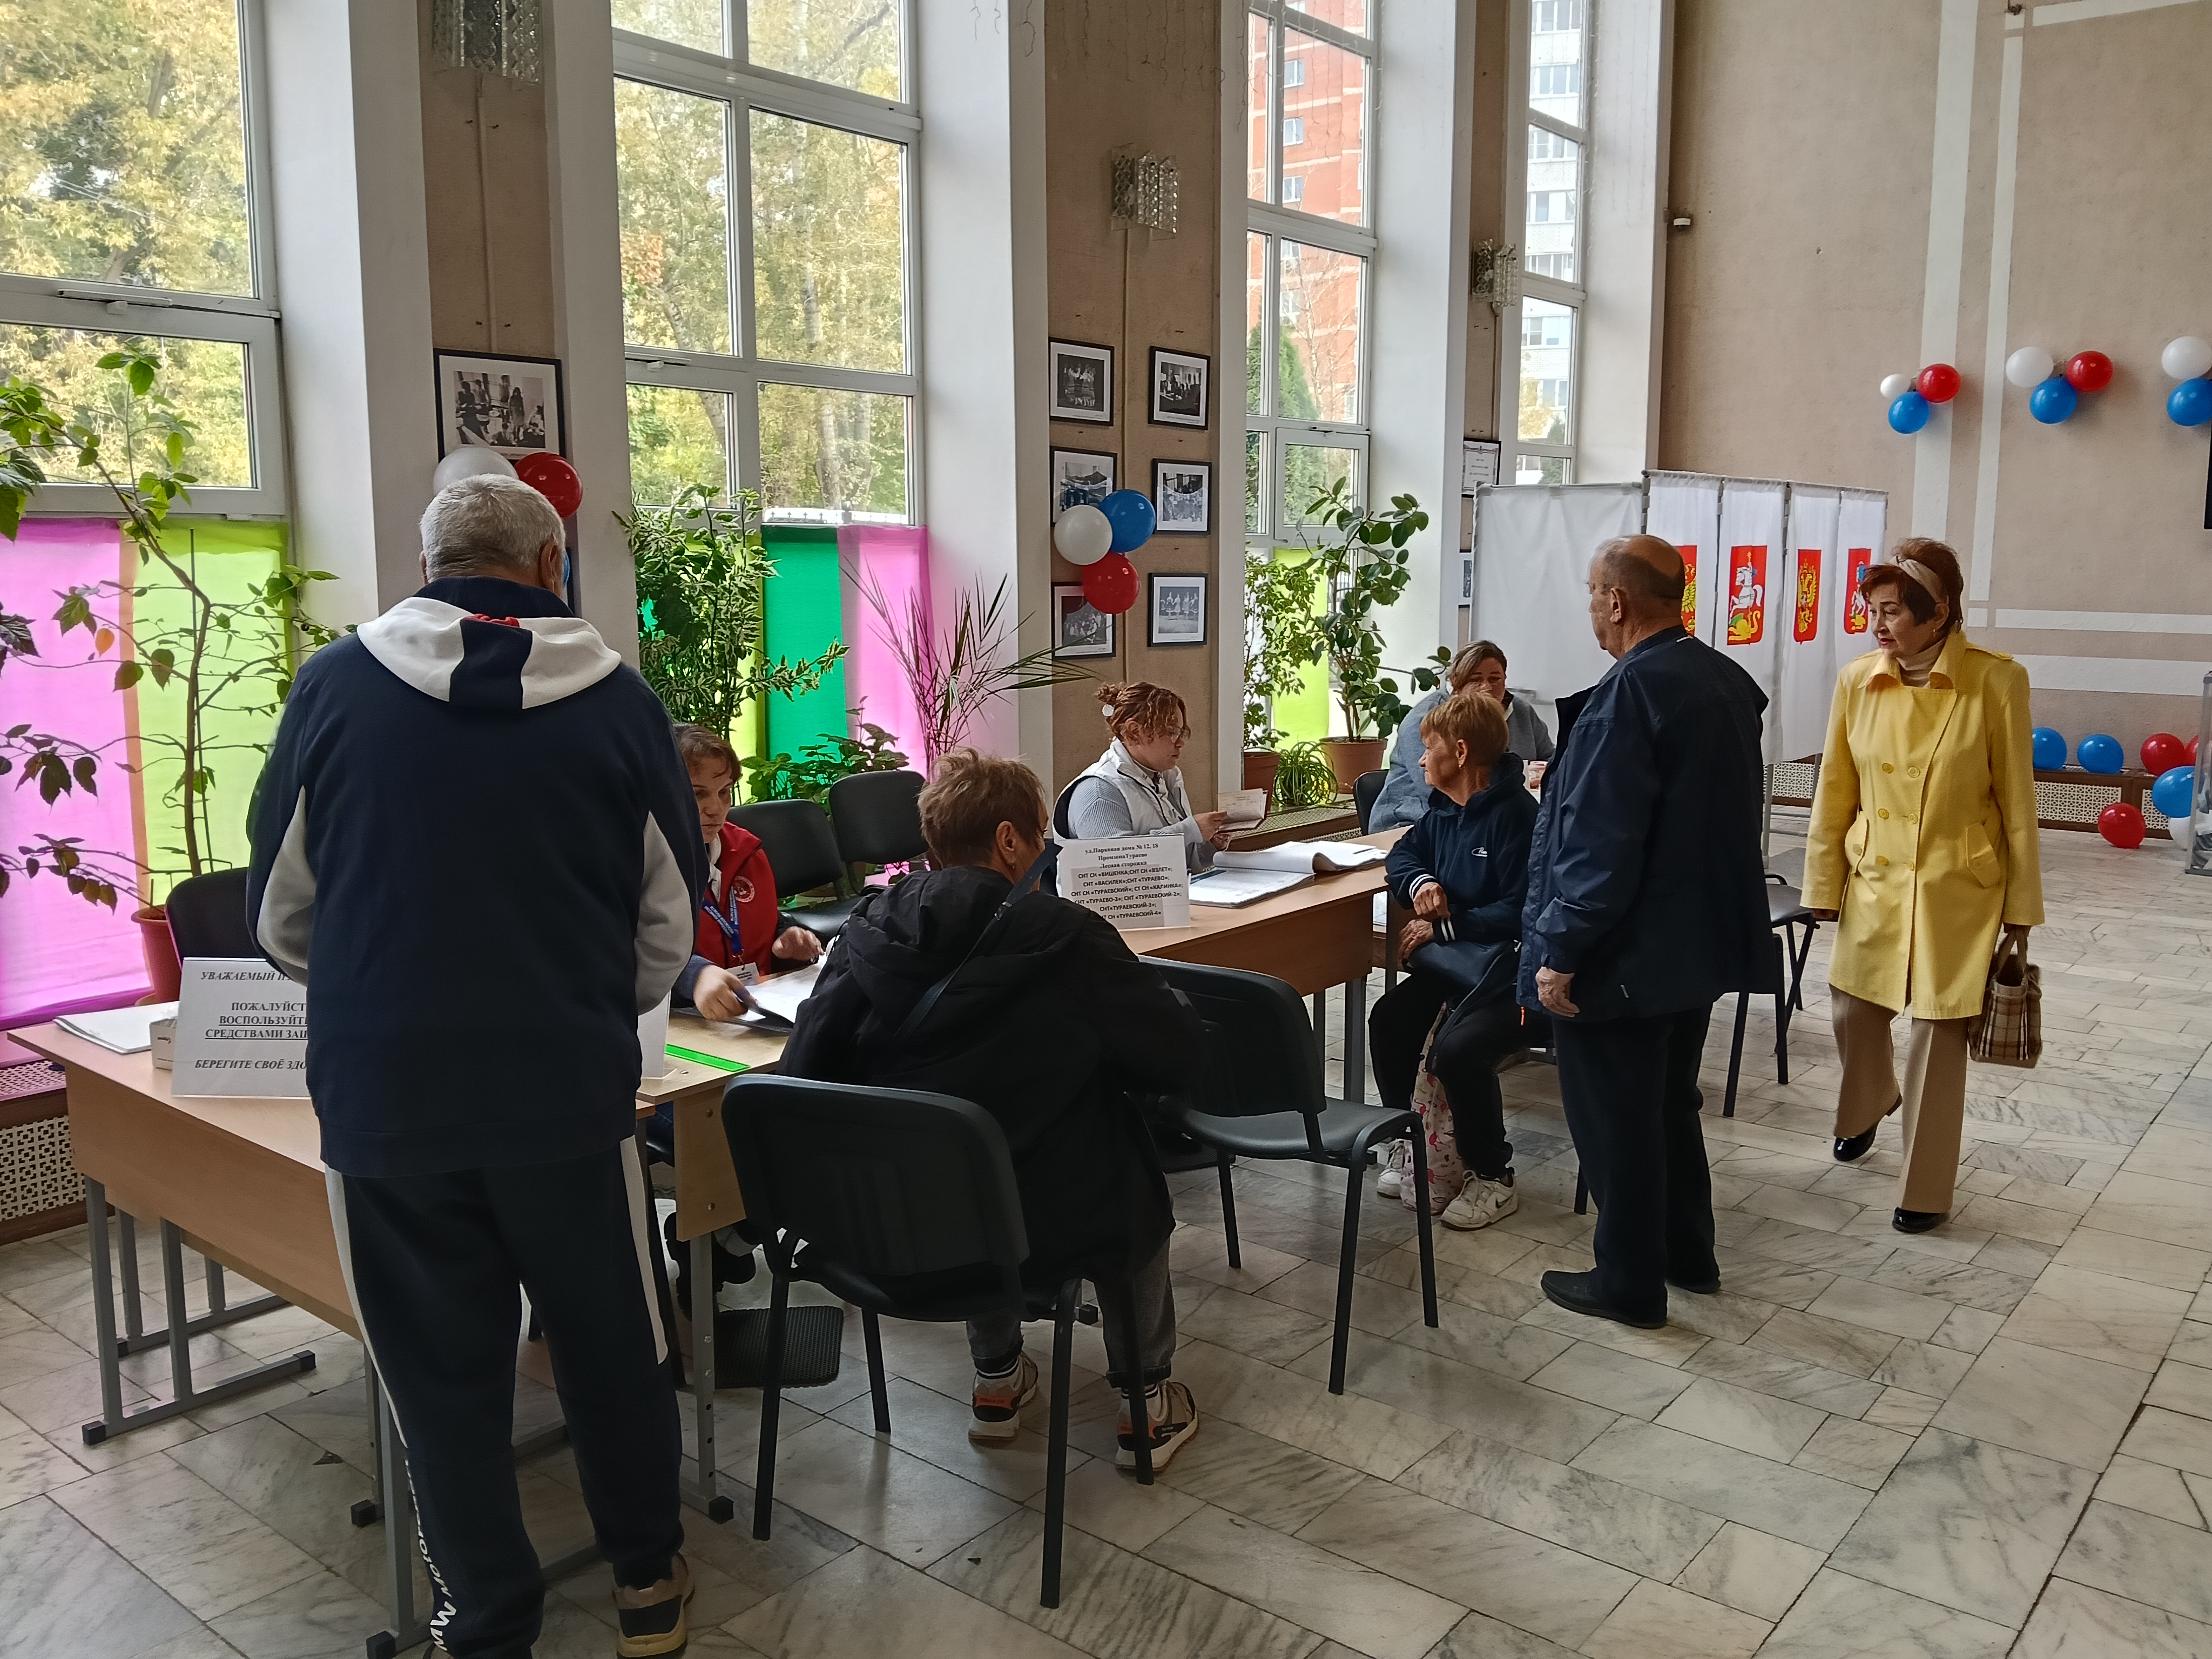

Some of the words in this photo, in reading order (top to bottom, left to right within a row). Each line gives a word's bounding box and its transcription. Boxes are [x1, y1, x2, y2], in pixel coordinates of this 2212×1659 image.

[1091, 886, 1133, 895] «ТУРАЕВСКИЙ»;
[1135, 891, 1182, 900] «ТУРАЕВСКИЙ-2»;
[1116, 909, 1162, 919] «ТУРАЕВСКИЙ-4»
[200, 970, 275, 981] УВАЖАЕМЫЙ
[231, 1001, 307, 1011] ПОЖАЛУЙСТ
[219, 1014, 307, 1025] ВОСПОЛЬЗУЙТ
[205, 1029, 283, 1038] СРЕДСТВАМИ
[285, 1029, 307, 1038] ЗАЩ
[194, 1060, 252, 1069] БЕРЕГИТЕ
[254, 1058, 284, 1069] СВОЁ
[285, 1060, 307, 1070] ЗДО
[430, 1601, 457, 1651] MW
